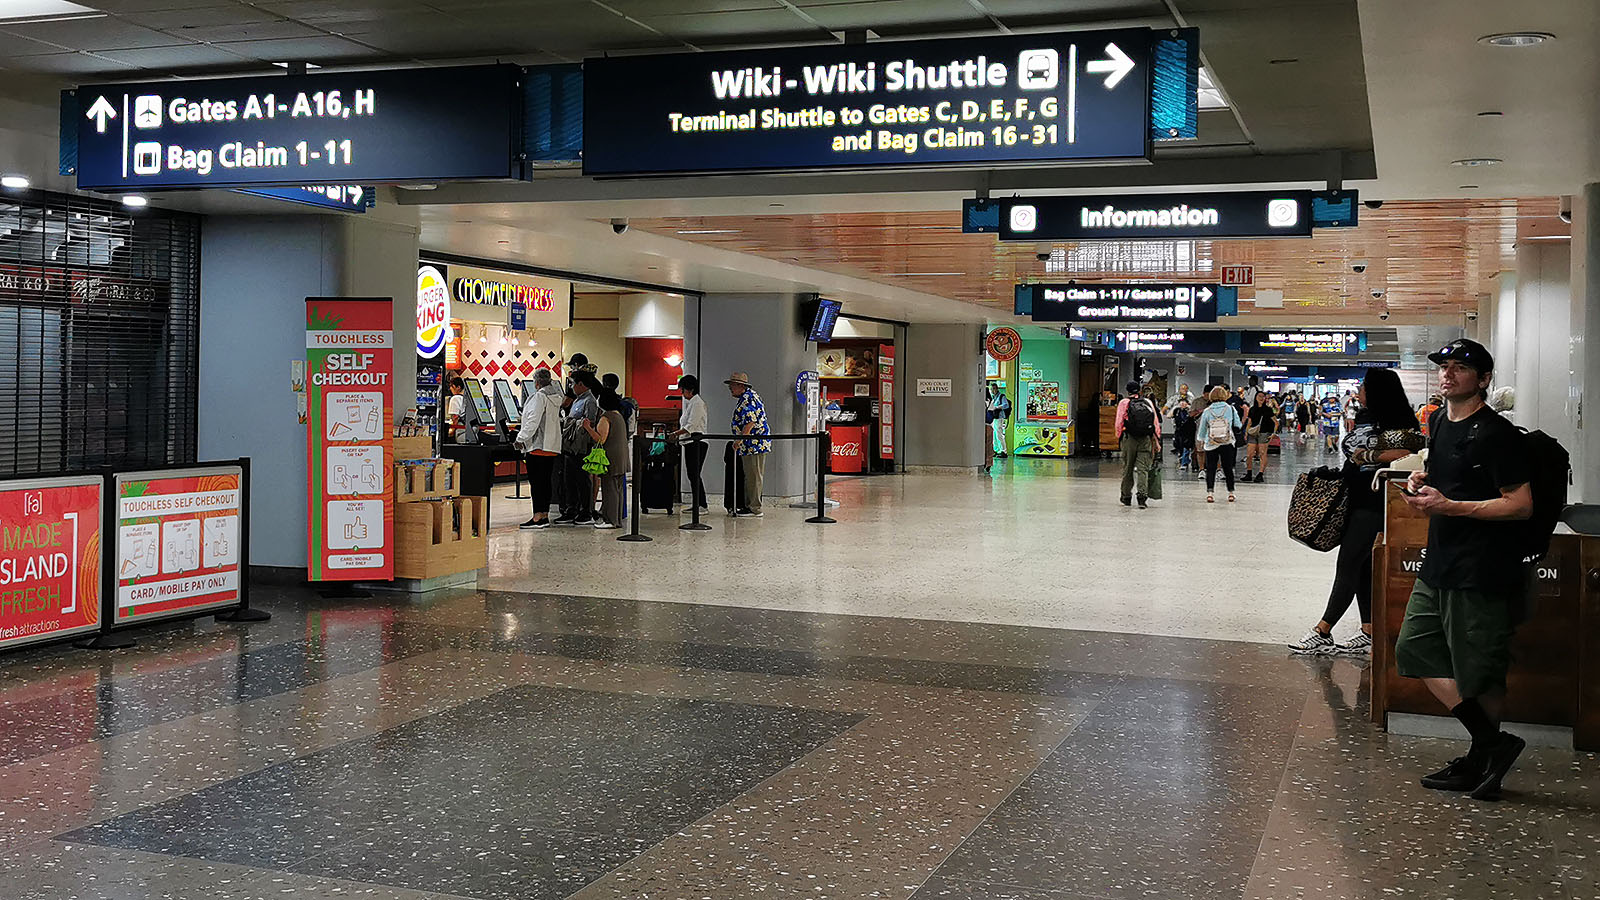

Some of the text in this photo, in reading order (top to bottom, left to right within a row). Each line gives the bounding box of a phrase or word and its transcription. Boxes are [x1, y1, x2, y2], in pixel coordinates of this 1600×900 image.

[885, 55, 1008, 91] Shuttle
[168, 97, 238, 123] Gates
[355, 88, 375, 116] H
[668, 108, 756, 132] Terminal
[761, 105, 836, 128] Shuttle
[840, 106, 864, 125] to
[868, 104, 930, 124] Gates
[1040, 96, 1058, 118] G
[831, 124, 1058, 154] and Bag Claim 16-31
[167, 139, 352, 175] Bag Claim 1-11
[1081, 204, 1219, 228] Information
[1226, 267, 1250, 284] EXIT
[1045, 289, 1066, 302] Bag
[1067, 288, 1097, 300] Claim
[1131, 288, 1164, 300] Gates
[1164, 289, 1174, 300] H
[1078, 306, 1174, 319] Ground Transport
[315, 334, 385, 344] TOUCHLESS
[326, 353, 375, 371] SELF
[312, 372, 389, 386] CHECKOUT
[123, 494, 235, 513] TOUCHLESS SELF CHECKOUT
[3, 522, 62, 551] MADE
[191, 580, 206, 592] PAY
[208, 576, 228, 589] ONLY
[1, 584, 60, 616] FRESH
